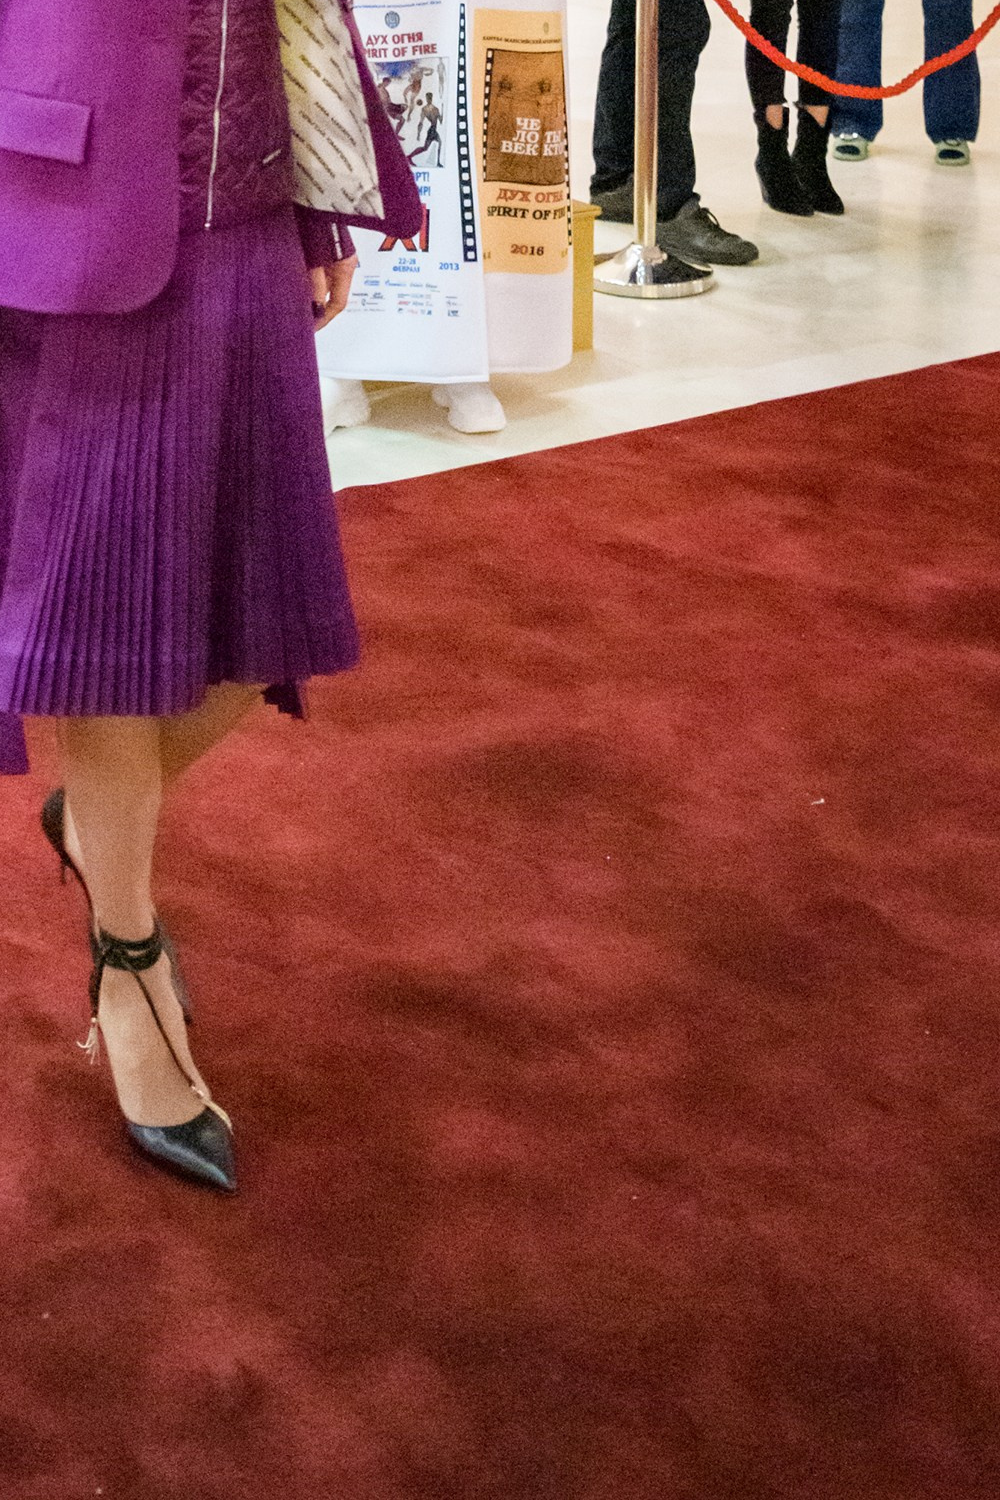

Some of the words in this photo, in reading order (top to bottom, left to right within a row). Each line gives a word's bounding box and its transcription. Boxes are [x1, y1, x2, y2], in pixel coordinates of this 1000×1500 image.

[366, 34, 389, 47] ДУХ
[391, 31, 423, 44] ОГНЯ
[392, 46, 408, 58] OF
[412, 43, 438, 56] FIRE
[515, 117, 541, 131] ЧЕ
[512, 129, 540, 144] ЛО
[501, 140, 540, 156] ВЕК
[497, 188, 531, 202] ДУХ
[488, 206, 529, 219] SPIRIT
[532, 209, 551, 220] OF
[510, 243, 545, 257] 2016
[438, 262, 460, 271] 2013
